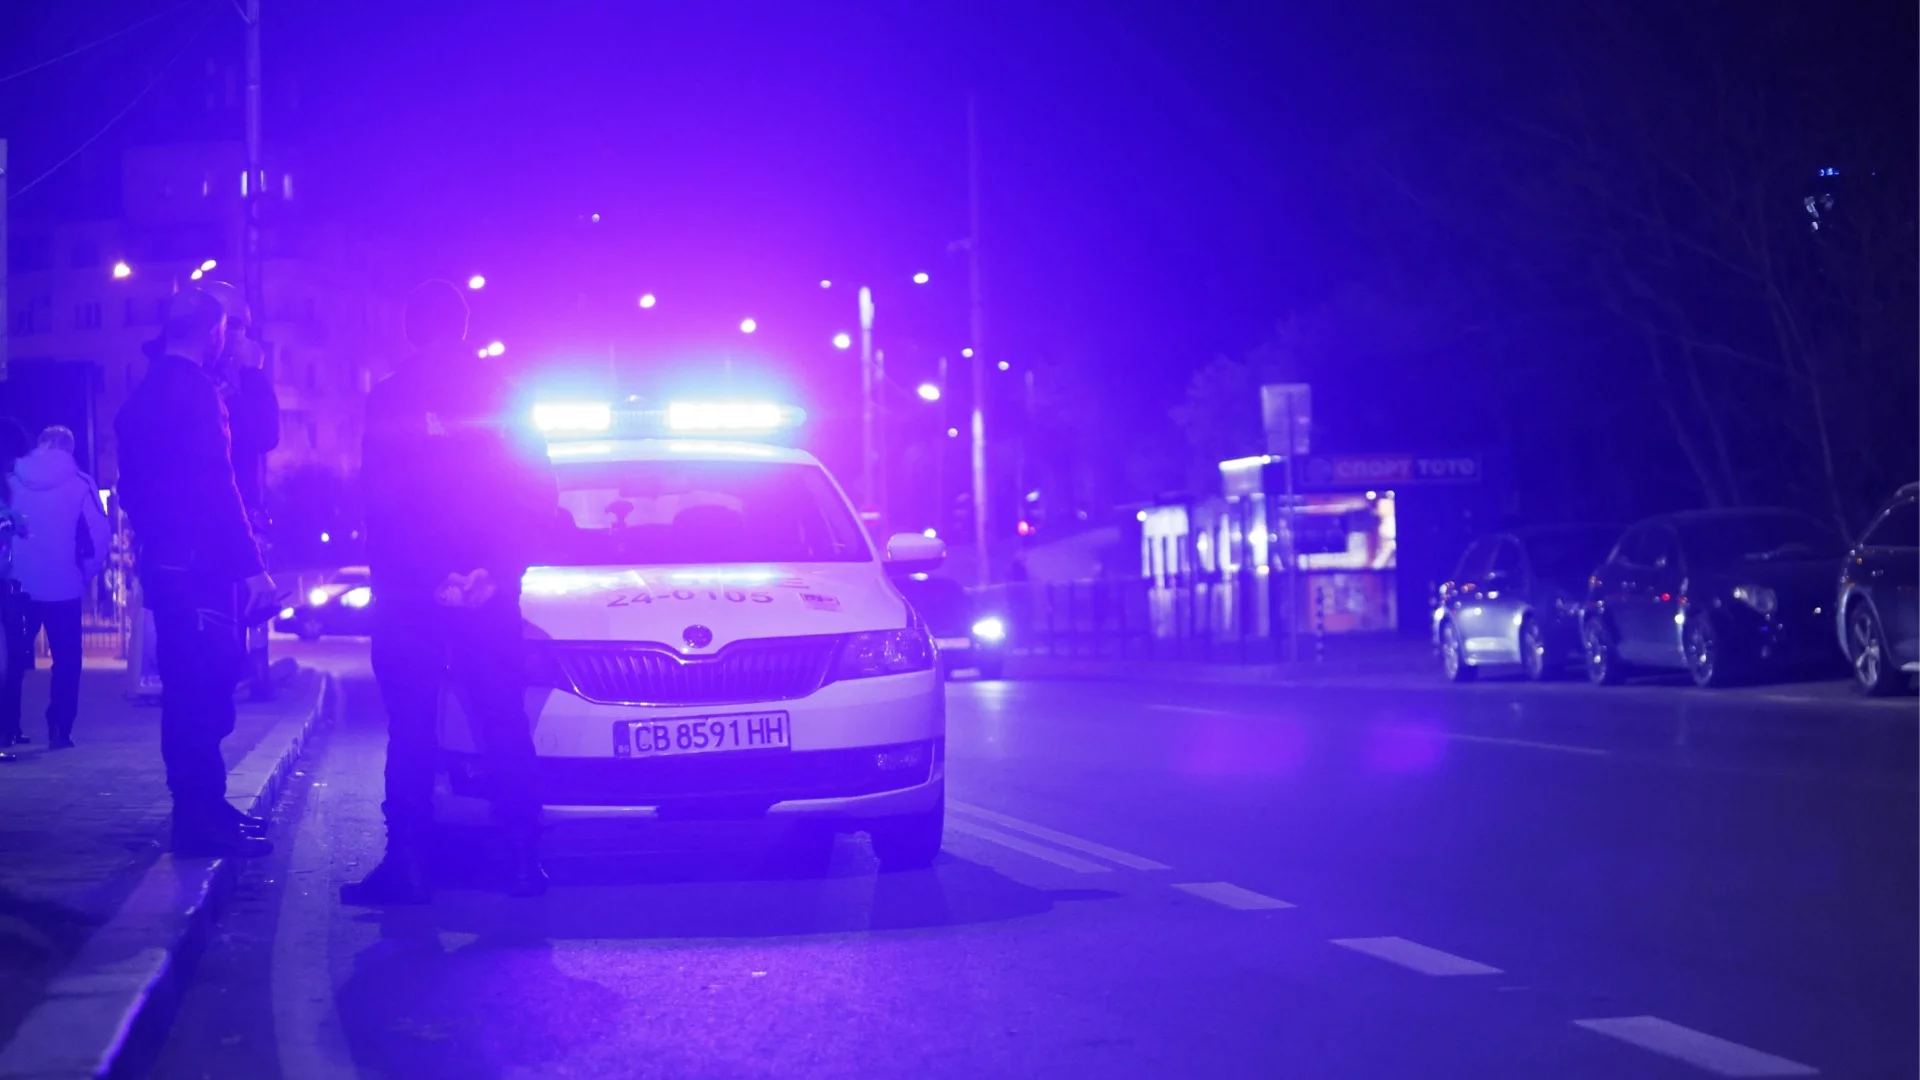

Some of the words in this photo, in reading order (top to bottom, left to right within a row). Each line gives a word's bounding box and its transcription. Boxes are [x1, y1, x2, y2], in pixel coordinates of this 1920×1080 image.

[1335, 460, 1411, 478] СПОРТ
[1417, 458, 1476, 475] ТОТО
[635, 725, 671, 752] CB
[676, 720, 740, 750] 8591
[747, 717, 783, 745] HH
